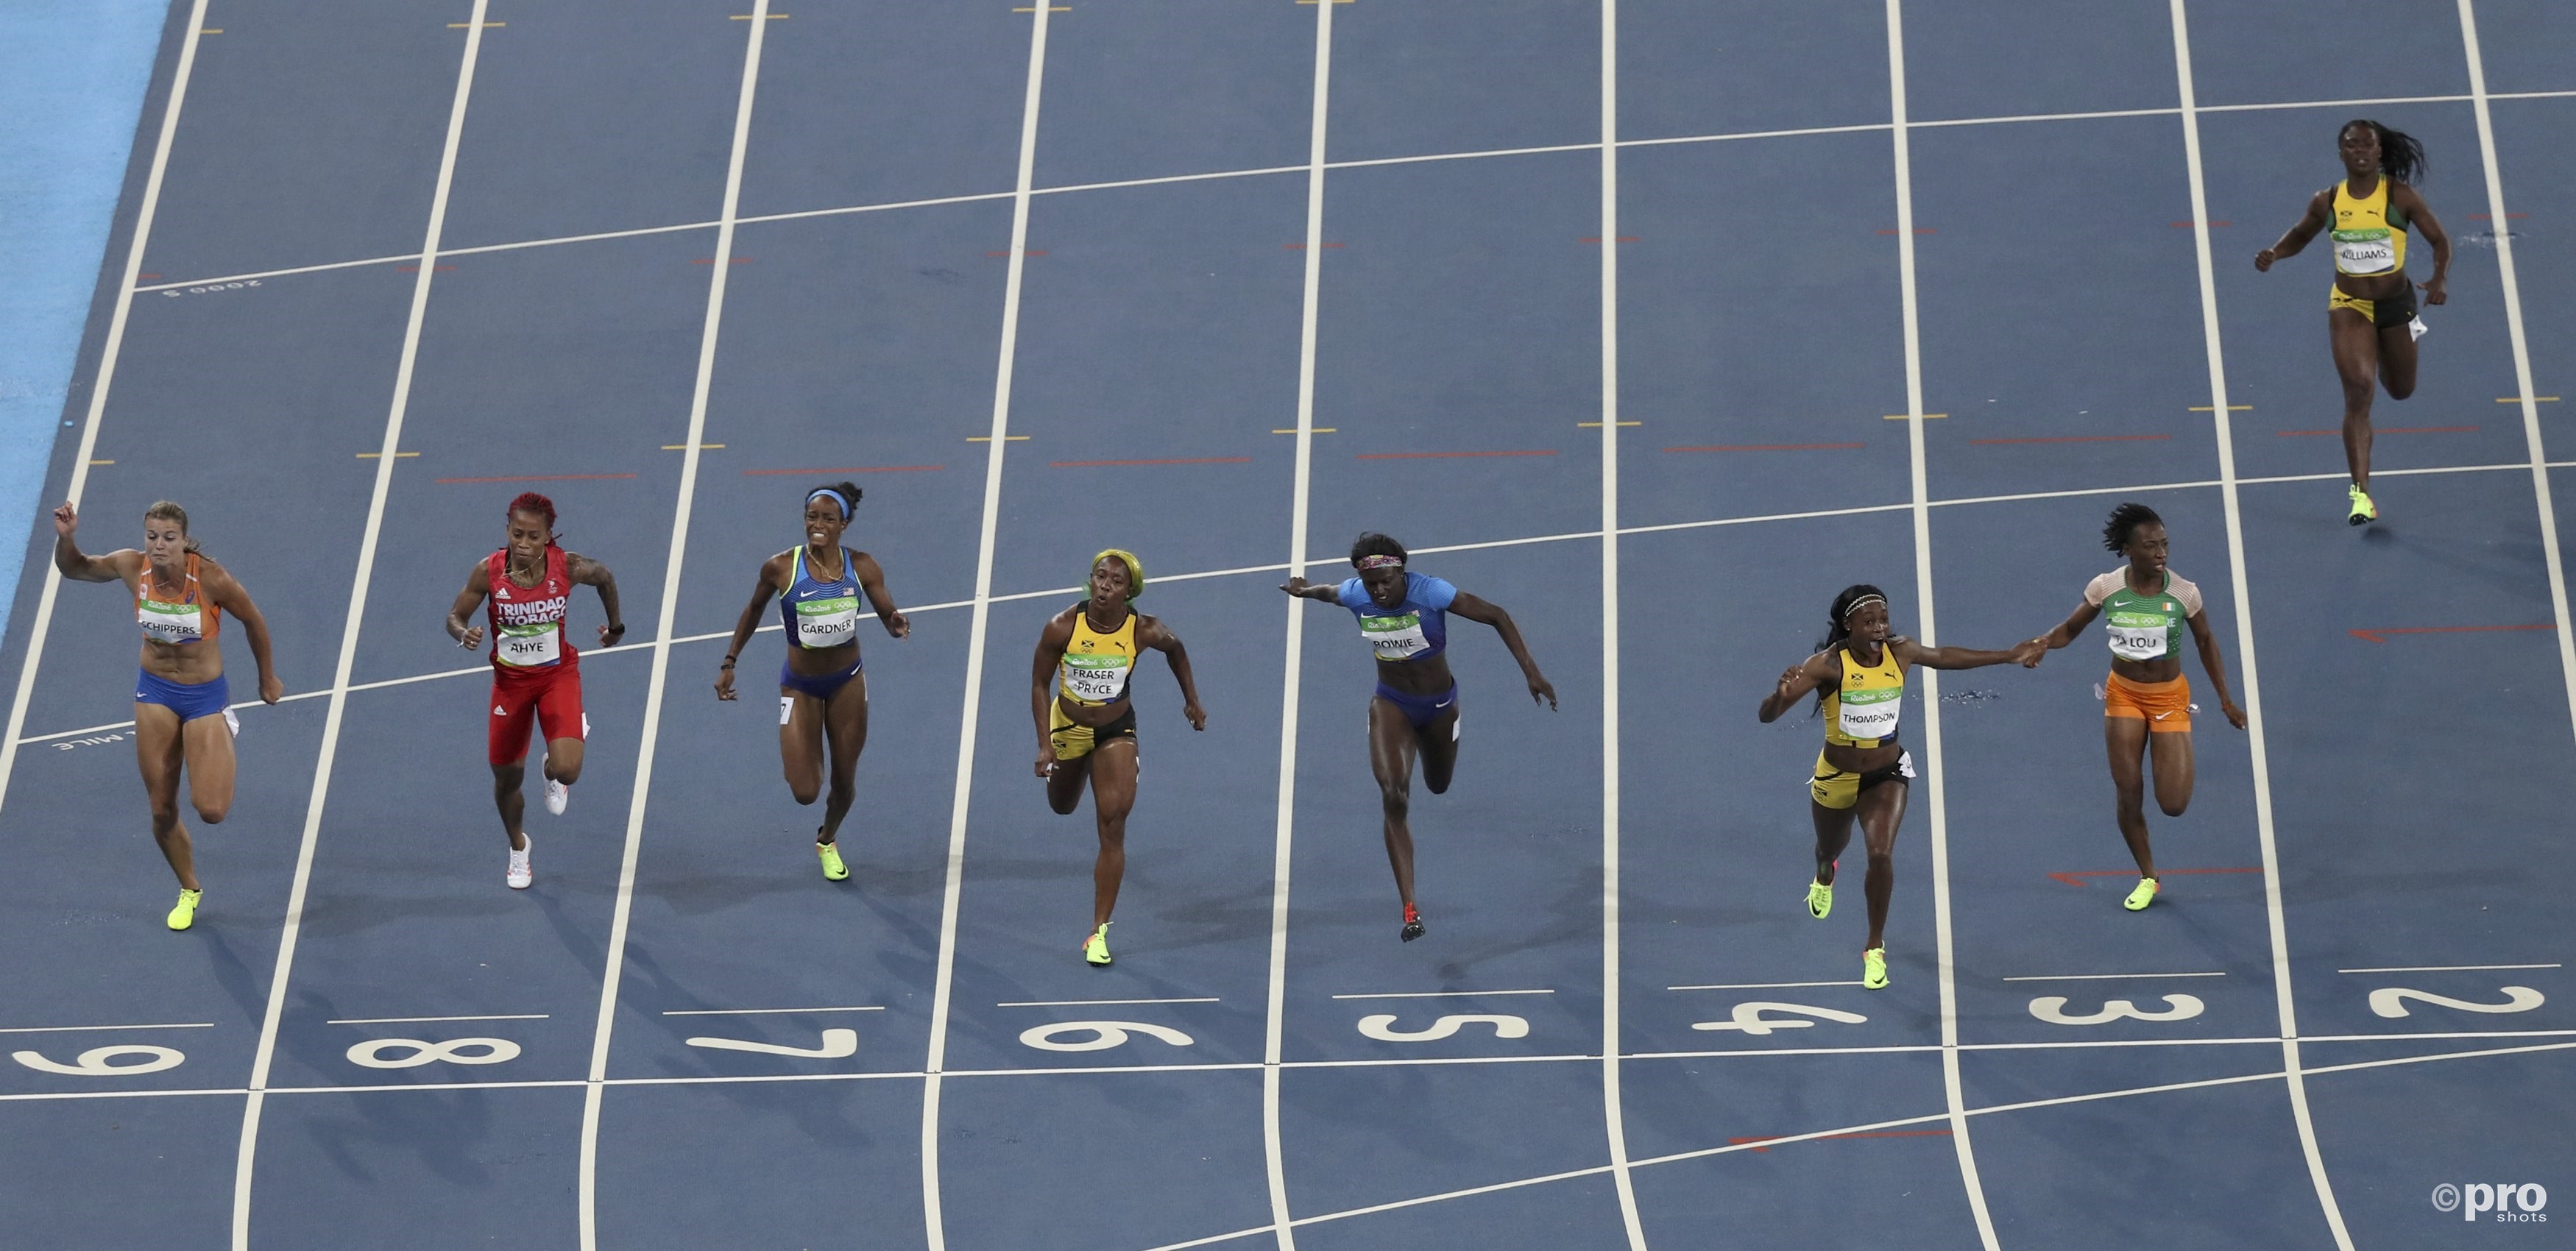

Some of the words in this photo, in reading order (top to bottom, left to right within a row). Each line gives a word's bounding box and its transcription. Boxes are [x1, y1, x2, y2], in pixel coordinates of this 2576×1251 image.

[2340, 249, 2386, 260] WILLIAMS
[189, 280, 263, 294] 2000
[496, 596, 566, 616] TRINIDAD
[141, 621, 195, 634] SCHIPPERS
[802, 619, 852, 634] GARDNER
[510, 642, 544, 653] AHYE
[1373, 639, 1415, 648] BOWIE
[2131, 637, 2156, 648] LOU
[1073, 668, 1114, 680] FRASER
[1074, 682, 1112, 694] -PRYCE
[1843, 712, 1895, 723] THOMPSON
[52, 734, 124, 751] MILE
[2028, 994, 2204, 1025] 3
[2368, 985, 2545, 1018] 2
[1691, 1002, 1868, 1035] 4
[1019, 1021, 1195, 1052] 6
[1358, 1014, 1530, 1043] 5
[685, 1028, 857, 1058] 7
[12, 1044, 185, 1077] 9
[346, 1038, 521, 1069] 8
